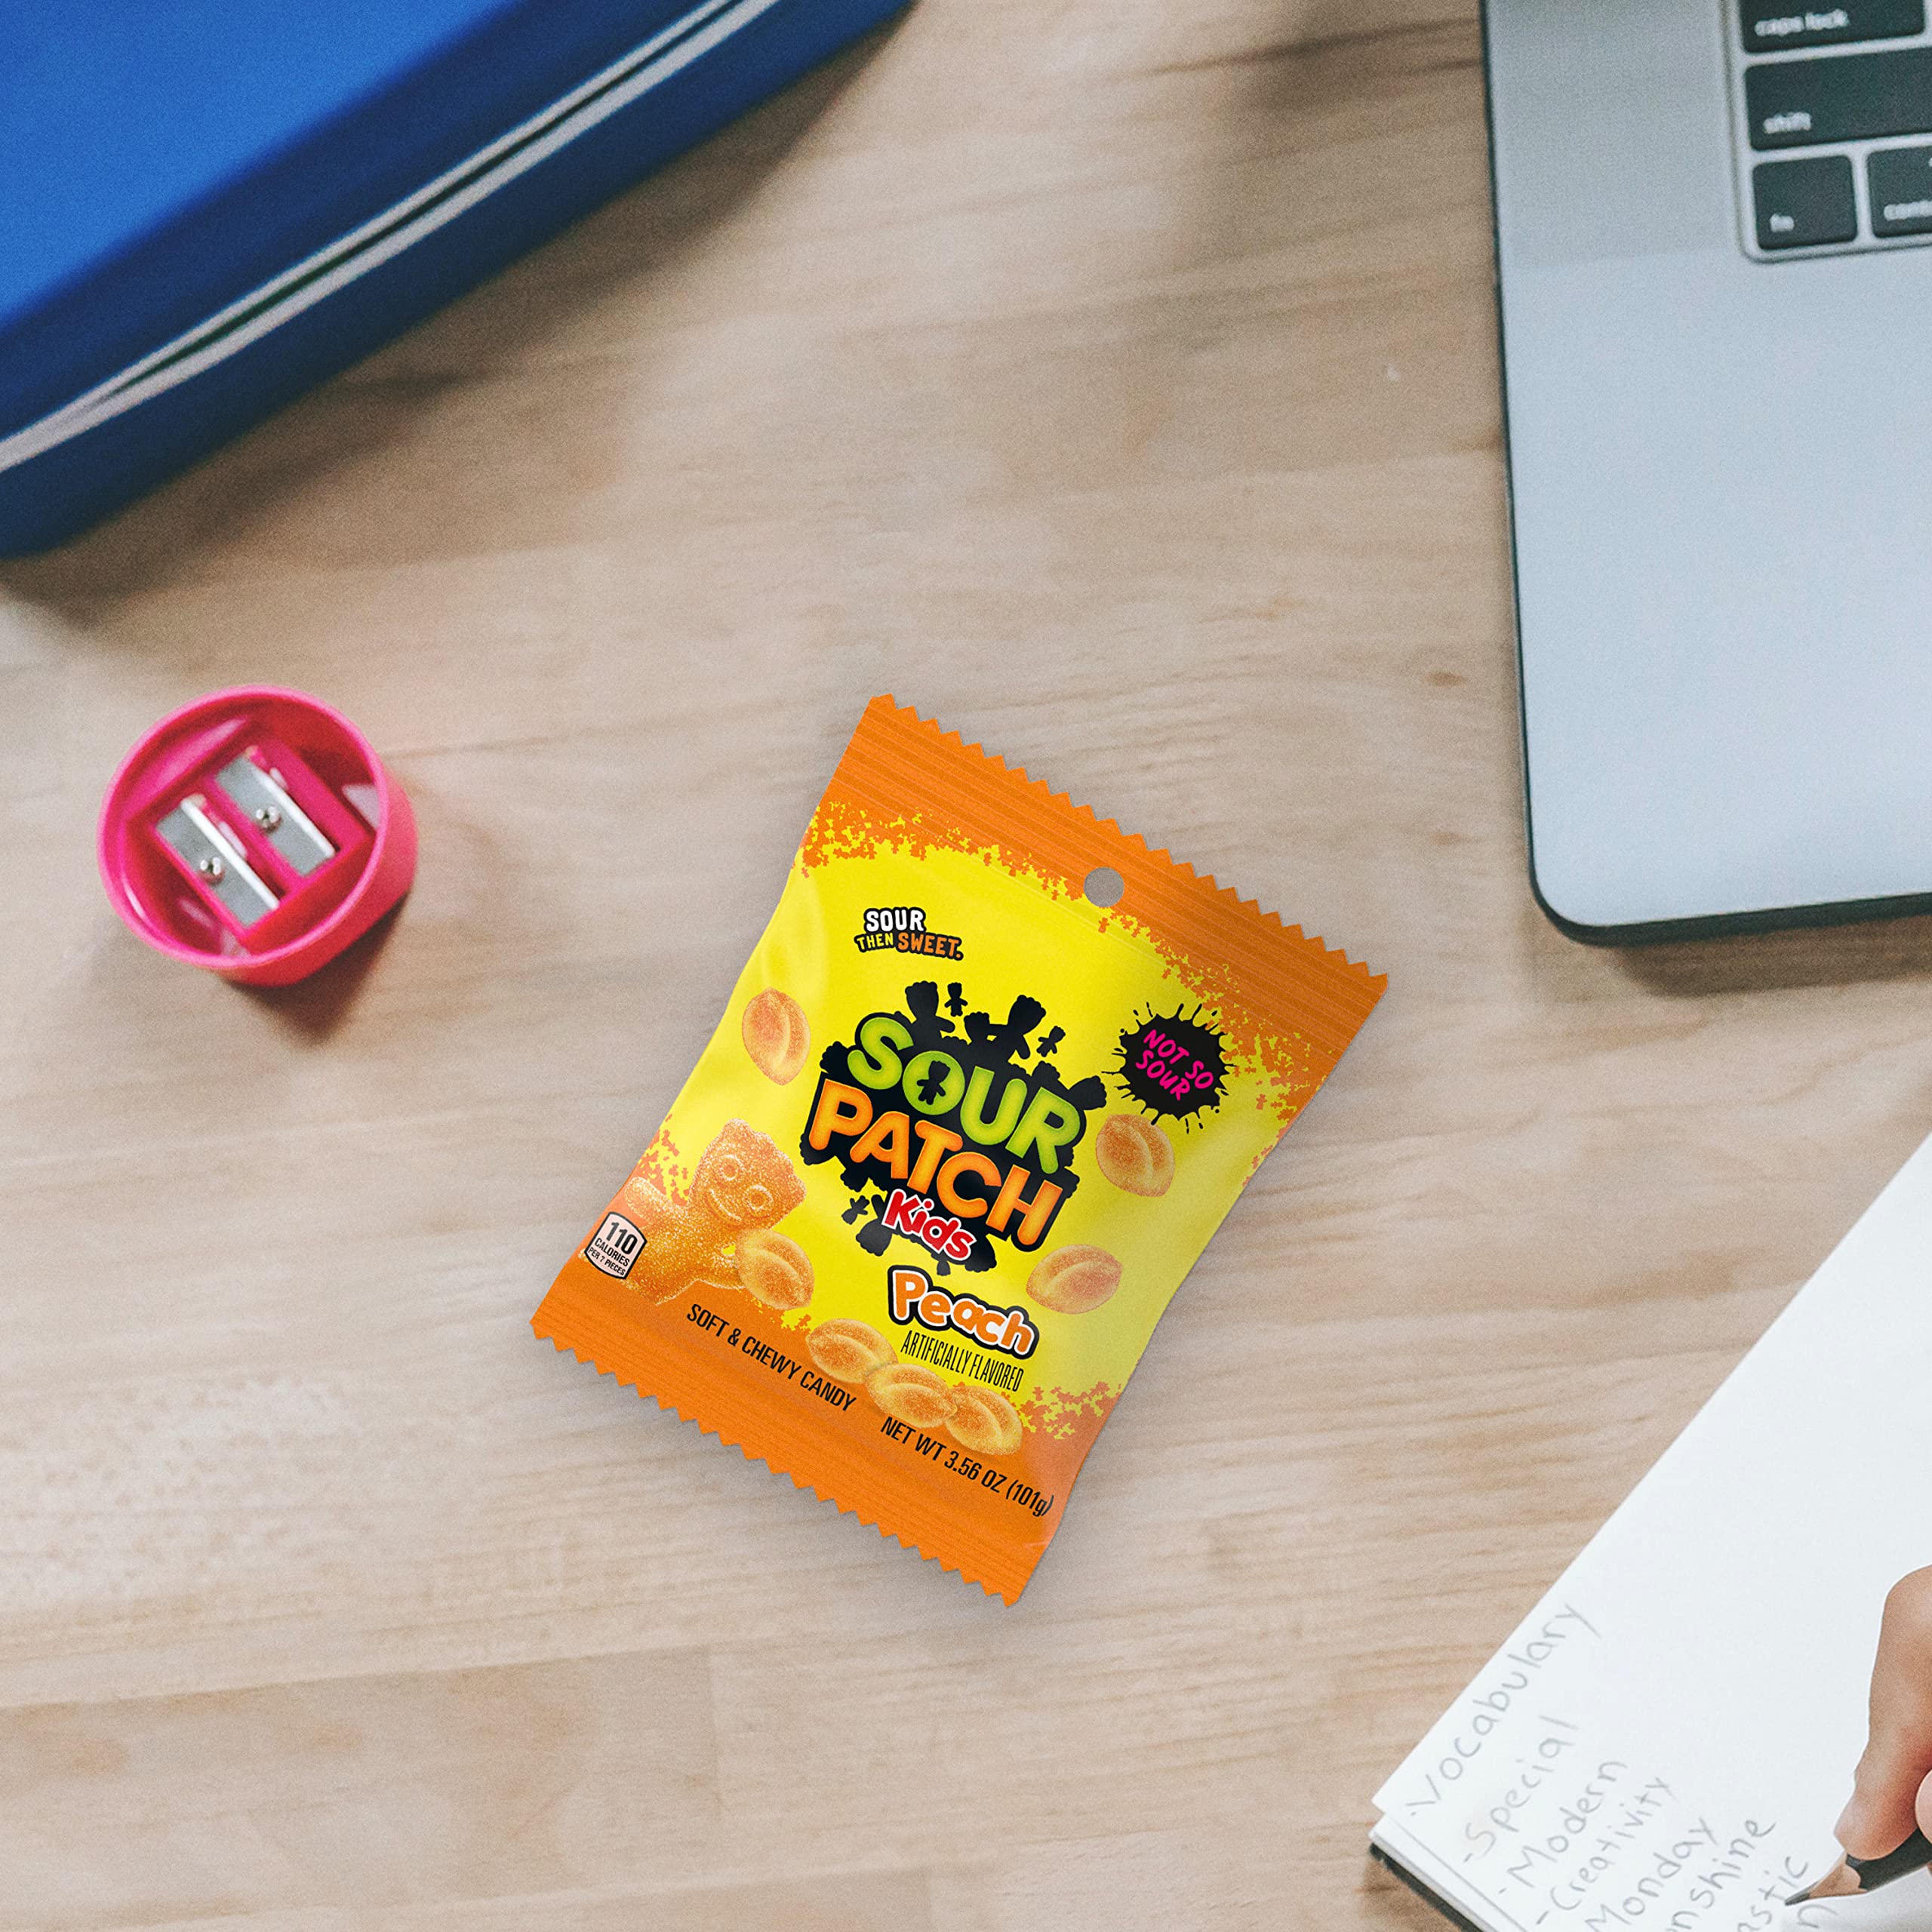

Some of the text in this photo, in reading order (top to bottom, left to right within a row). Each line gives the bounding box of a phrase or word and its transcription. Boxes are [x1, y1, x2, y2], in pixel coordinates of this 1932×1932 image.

[857, 932, 961, 958] THEN SWEET.
[866, 909, 924, 932] SOUR
[1135, 1050, 1191, 1101] SOUR
[1143, 1029, 1214, 1089] NOT SO
[847, 1017, 1081, 1175] SOUR
[808, 1079, 1063, 1246] PATCH
[594, 1238, 630, 1267] CALORIES
[606, 1222, 638, 1255] 110
[882, 1189, 977, 1261] Kids
[588, 1247, 599, 1260] PER
[604, 1259, 626, 1275] PIECES
[893, 1269, 1035, 1355] Peach
[686, 1303, 857, 1412] SOFT & CHEWY CANDY
[900, 1330, 1025, 1392] ARTIFICIALLY FLAVORED
[880, 1416, 1055, 1518] NET WT 3.56 OZ (101g)
[1585, 1815, 1720, 1932] Monday
